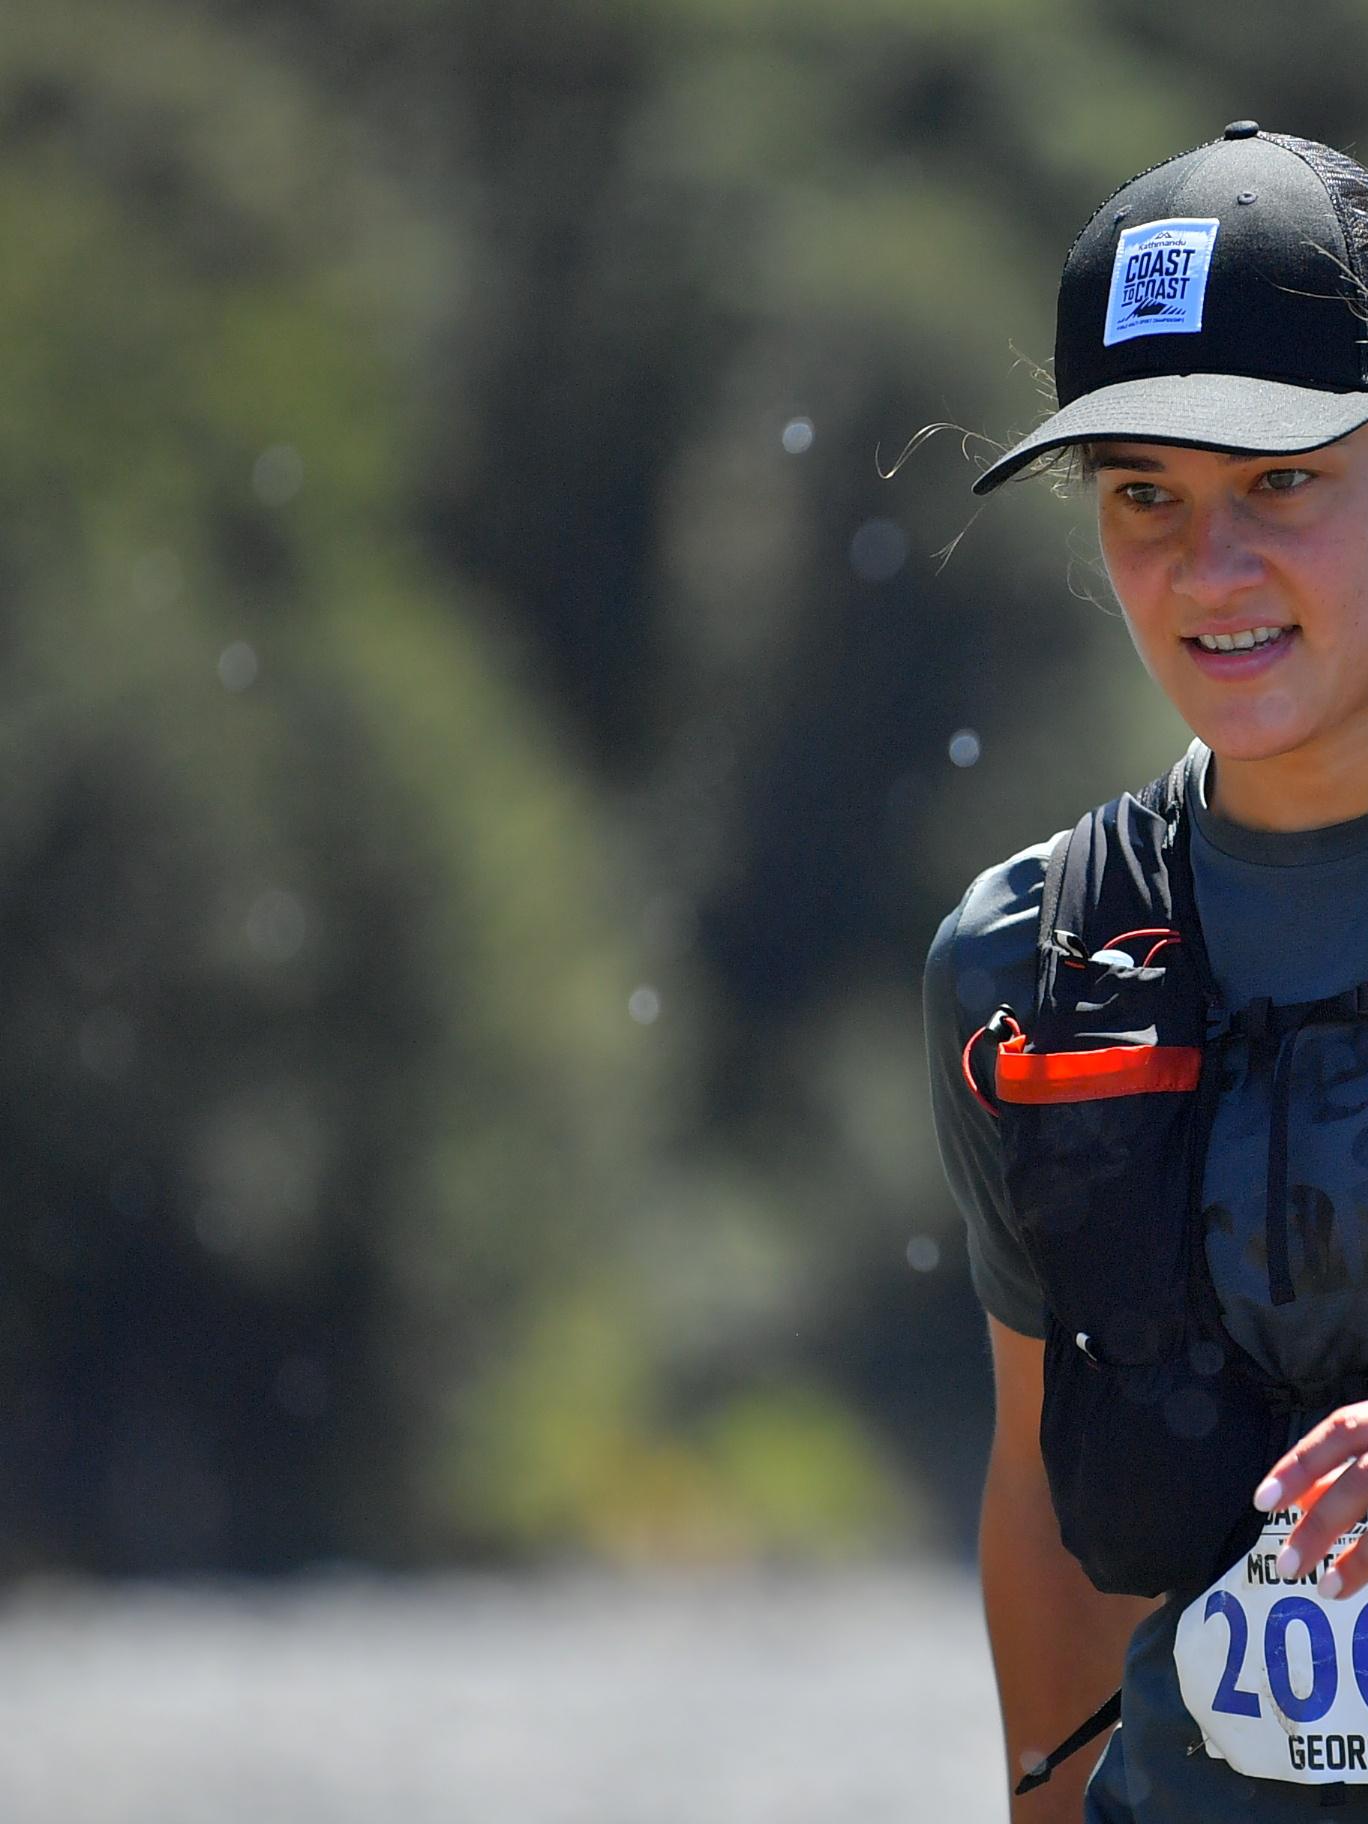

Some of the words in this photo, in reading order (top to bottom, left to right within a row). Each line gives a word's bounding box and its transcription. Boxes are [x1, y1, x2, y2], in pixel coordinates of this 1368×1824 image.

[1125, 249, 1195, 283] COAST
[1123, 286, 1135, 302] TO
[1135, 277, 1190, 303] COAST
